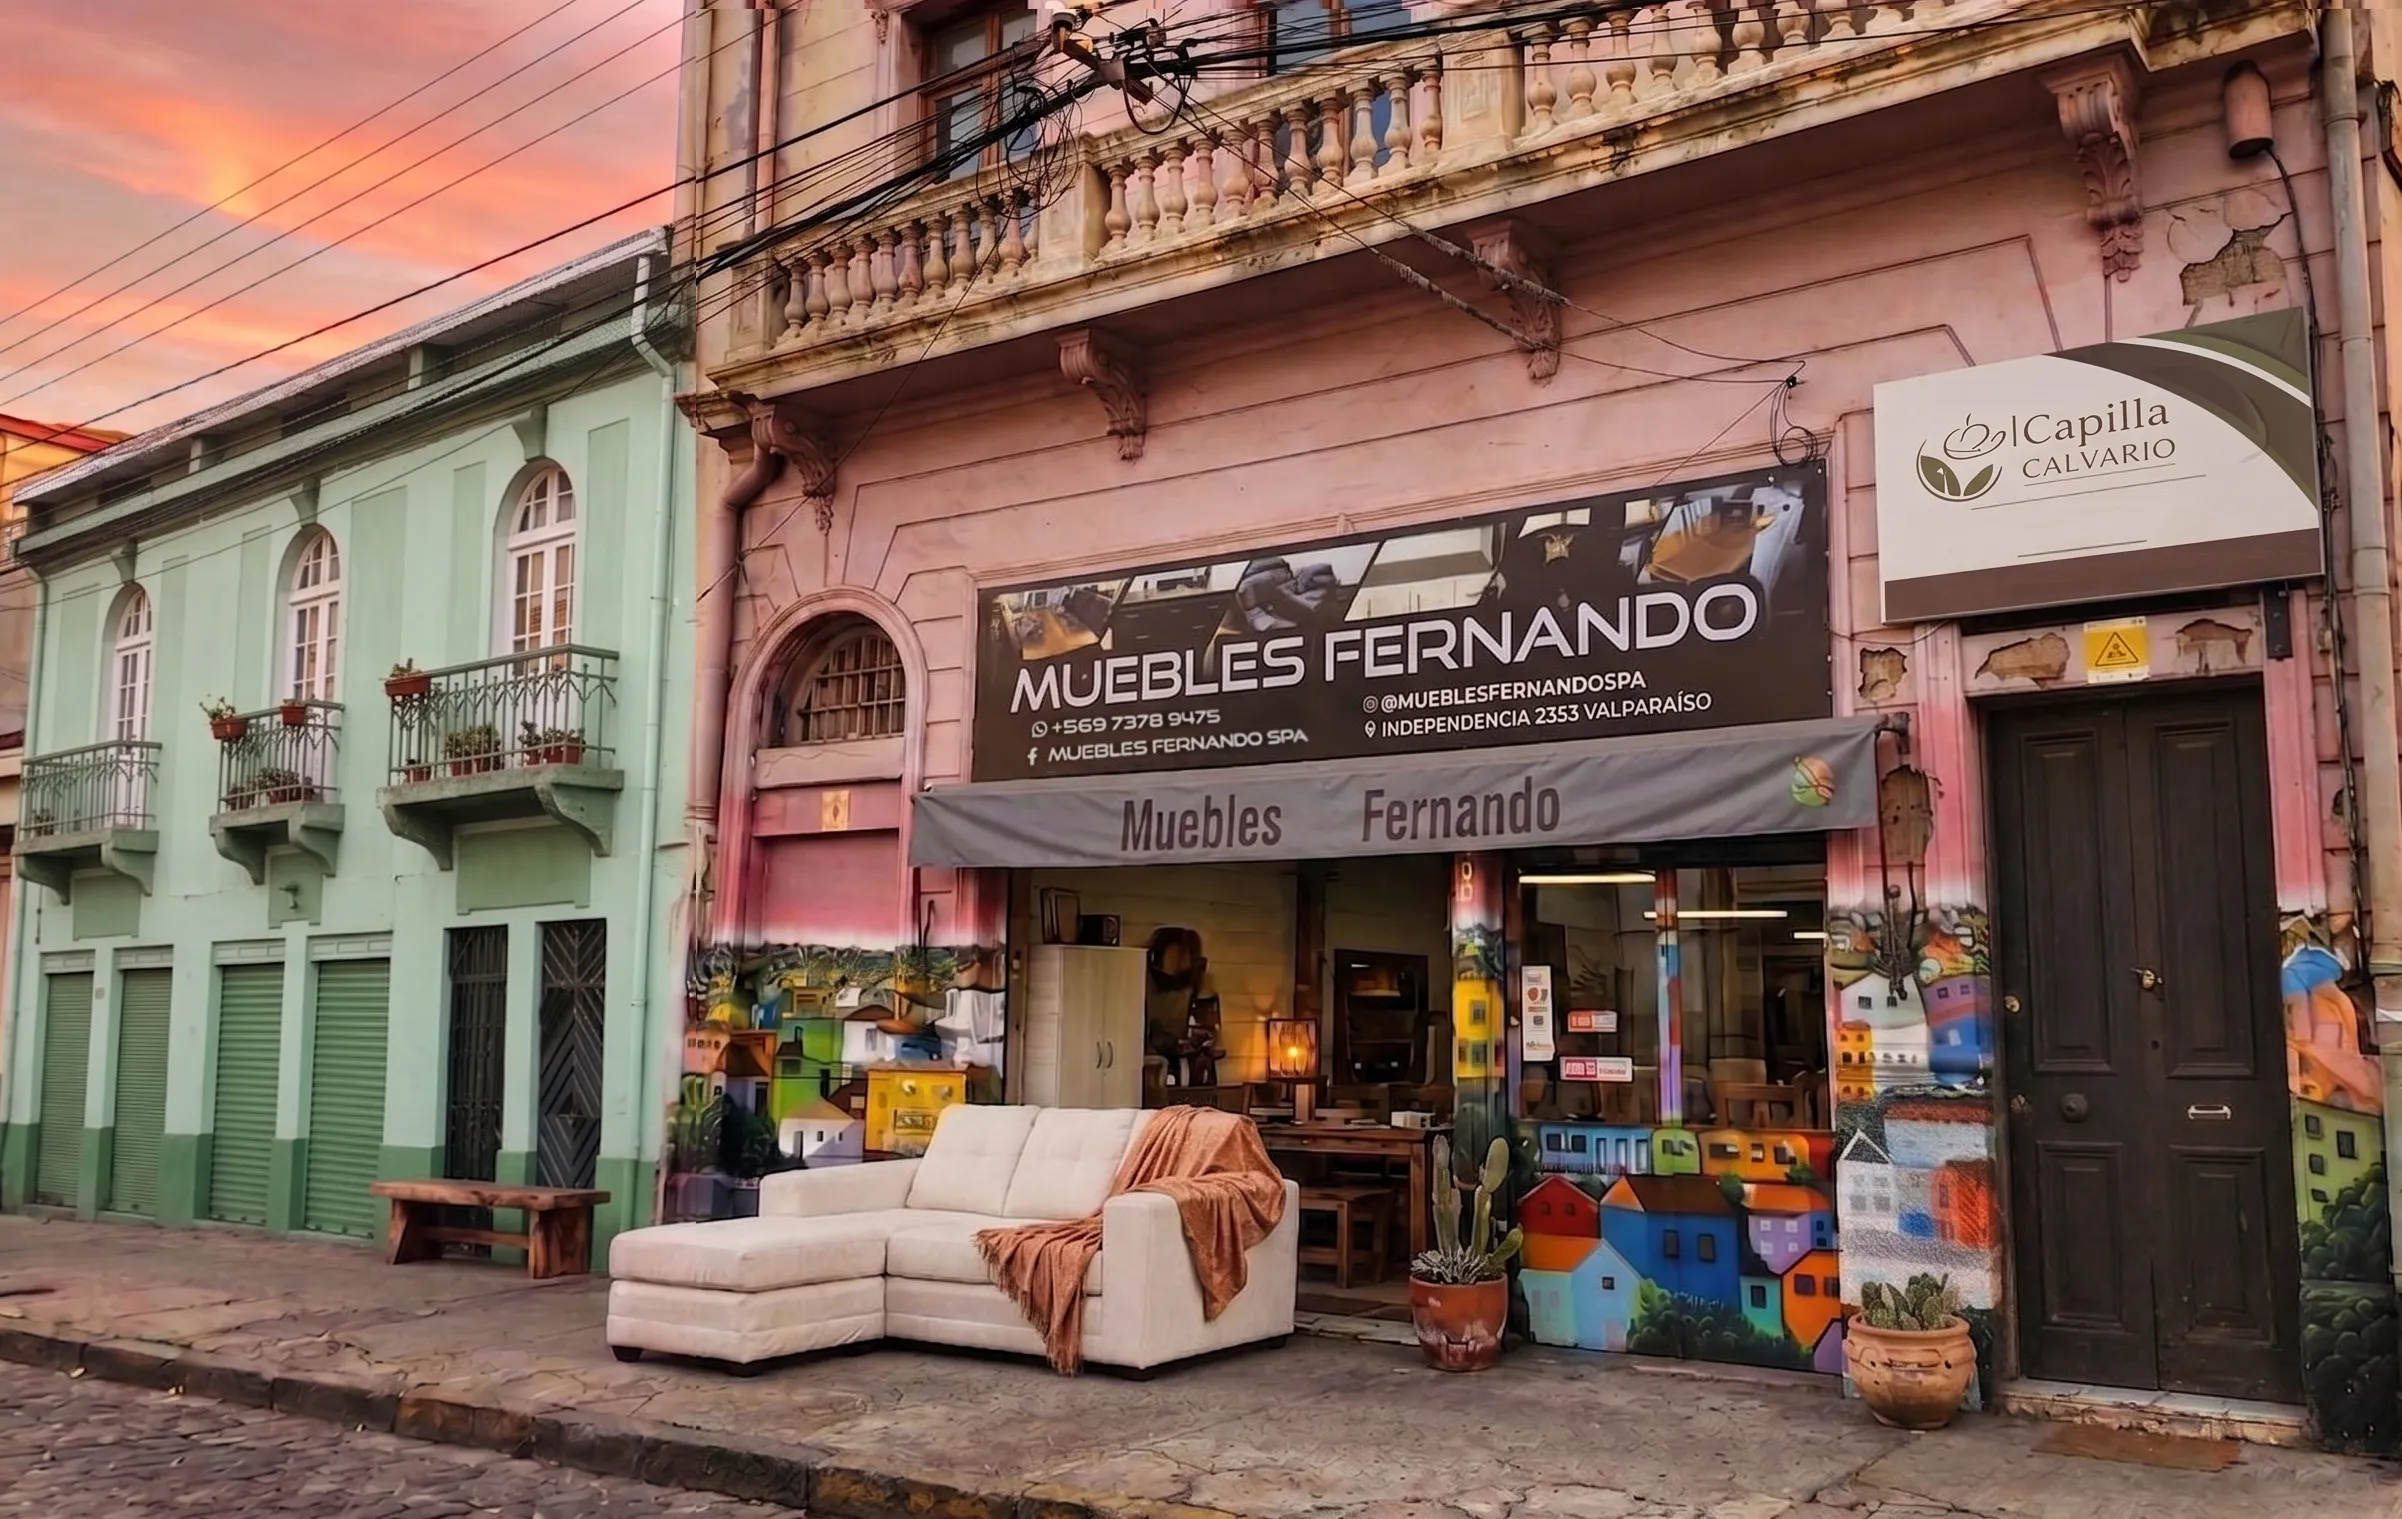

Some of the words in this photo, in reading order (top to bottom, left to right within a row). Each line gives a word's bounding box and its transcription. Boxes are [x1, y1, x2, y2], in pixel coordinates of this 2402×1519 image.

[2023, 398, 2170, 448] Capilla
[2022, 438, 2176, 479] CALVARIO
[1010, 636, 1305, 713] MUEBLES
[1324, 583, 1758, 682] FERNANDO
[1380, 671, 1647, 714] @MUEBLESFERNANDOSPA
[1382, 712, 1530, 738] INDEPENDENCIA
[1535, 706, 1580, 726] 2353
[1584, 691, 1712, 720] VALPARAÍSO
[1051, 718, 1107, 735] +569
[1111, 714, 1164, 731] 7378
[1168, 709, 1221, 726] 9475
[1048, 741, 1148, 763] MUEBLES
[1152, 732, 1263, 754] FERNANDO
[1267, 729, 1309, 744] SPA
[1121, 795, 1282, 851] Muebles
[1362, 776, 1561, 842] Fernando
